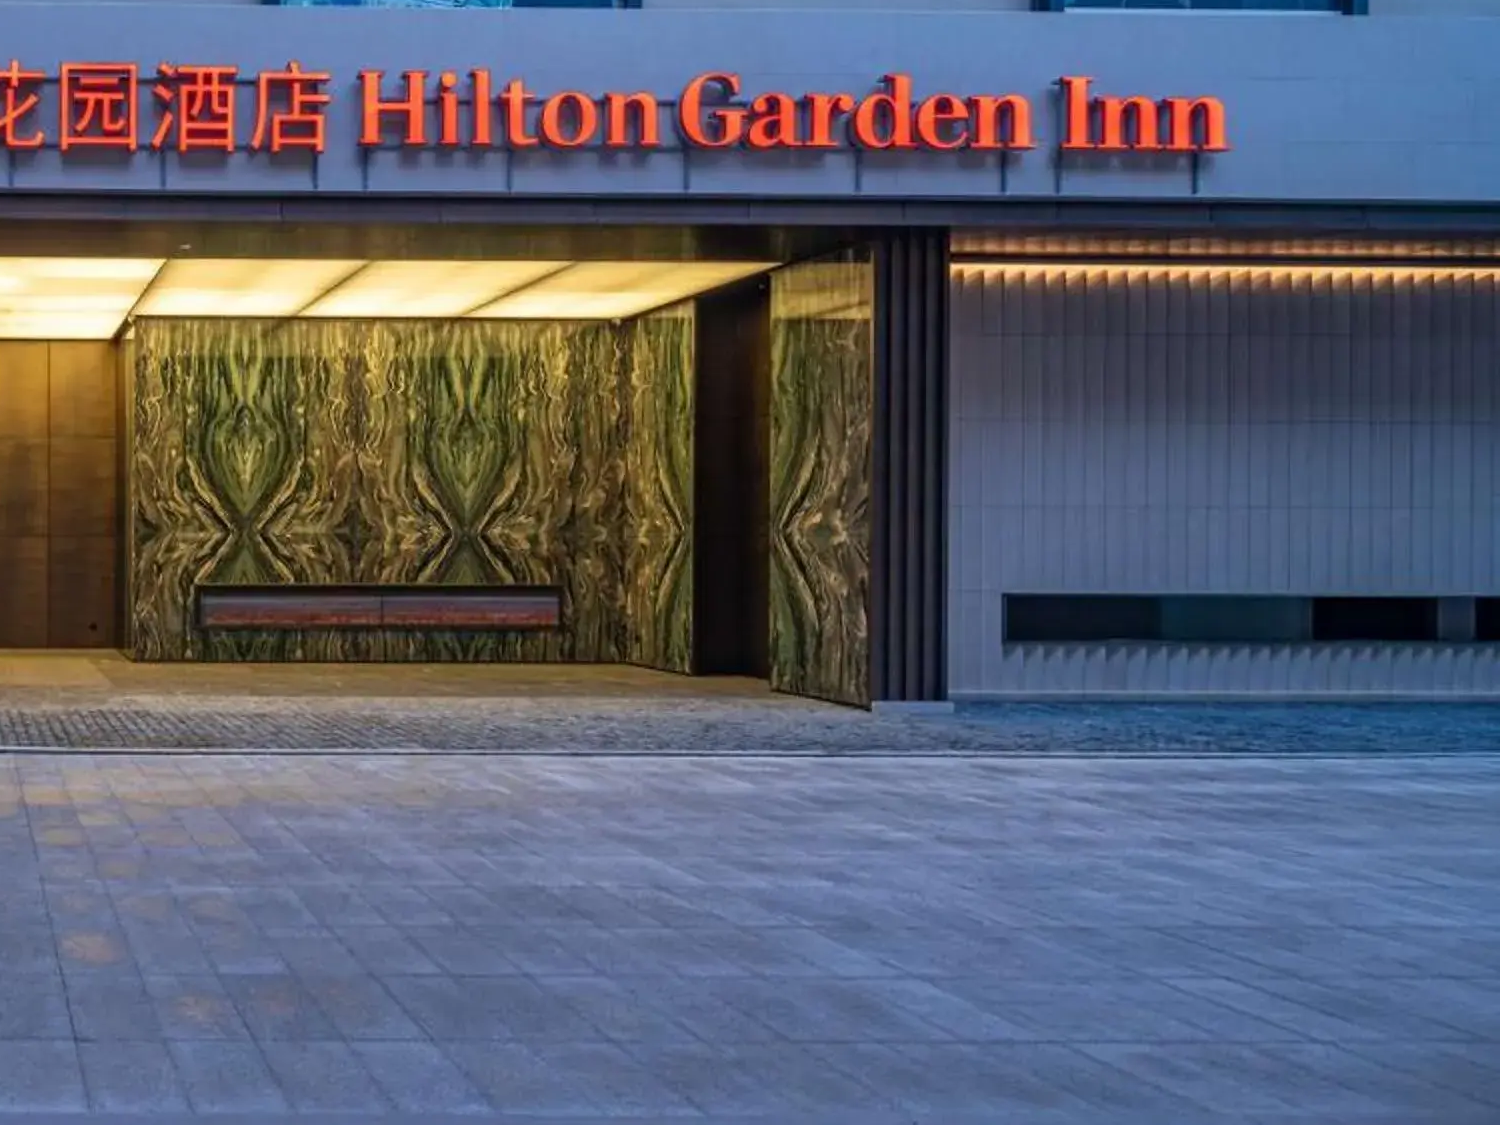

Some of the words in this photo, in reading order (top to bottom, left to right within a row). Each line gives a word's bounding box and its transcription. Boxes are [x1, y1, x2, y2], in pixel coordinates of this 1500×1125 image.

[358, 69, 660, 150] Hilton
[679, 73, 1034, 151] Garden
[1060, 76, 1228, 152] Inn
